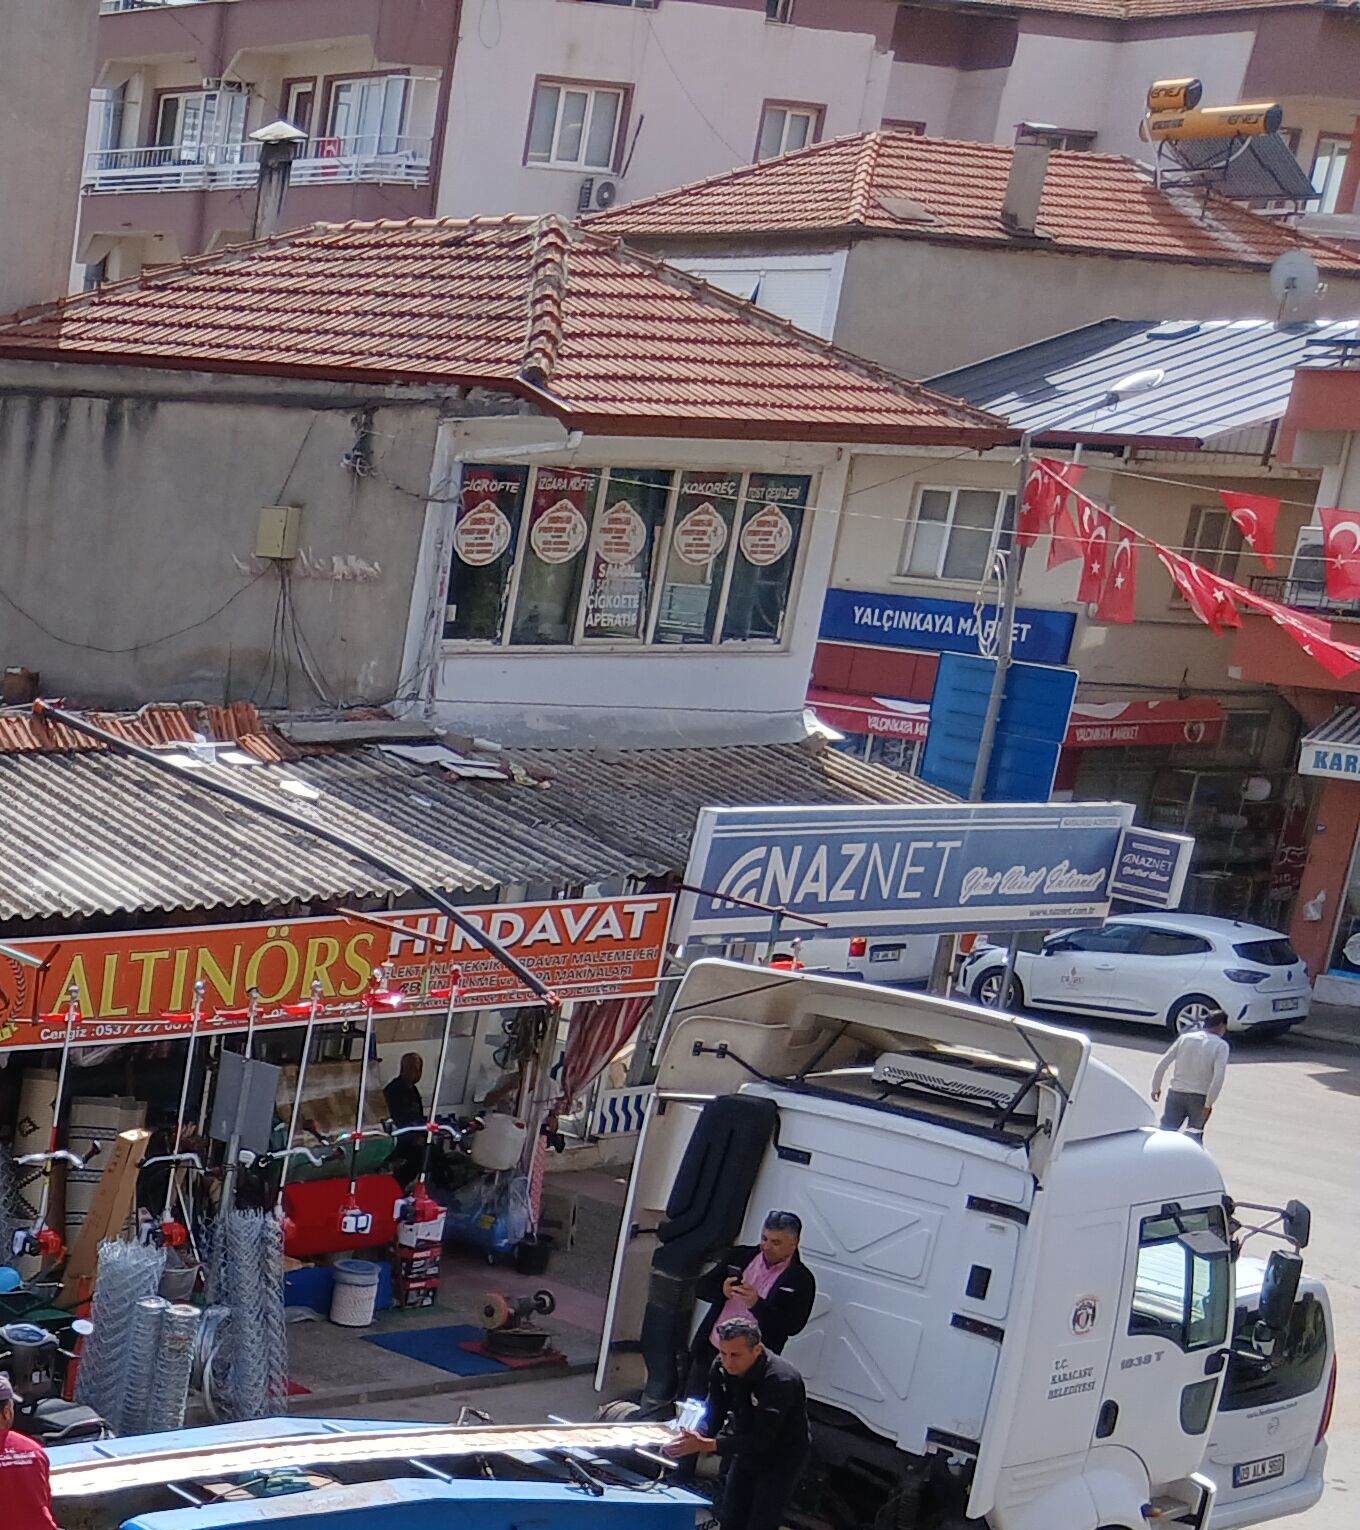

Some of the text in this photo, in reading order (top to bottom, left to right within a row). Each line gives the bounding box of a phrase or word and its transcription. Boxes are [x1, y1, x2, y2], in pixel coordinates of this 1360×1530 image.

[853, 605, 1032, 643] YALÇINKAYA MARET
[1312, 750, 1360, 776] KAR
[757, 841, 962, 906] NAZNET
[51, 924, 377, 1019] ALTINÖRS
[40, 1026, 88, 1041] Cengiz
[1153, 1350, 1165, 1362] T
[1050, 1366, 1095, 1385] KARACASU
